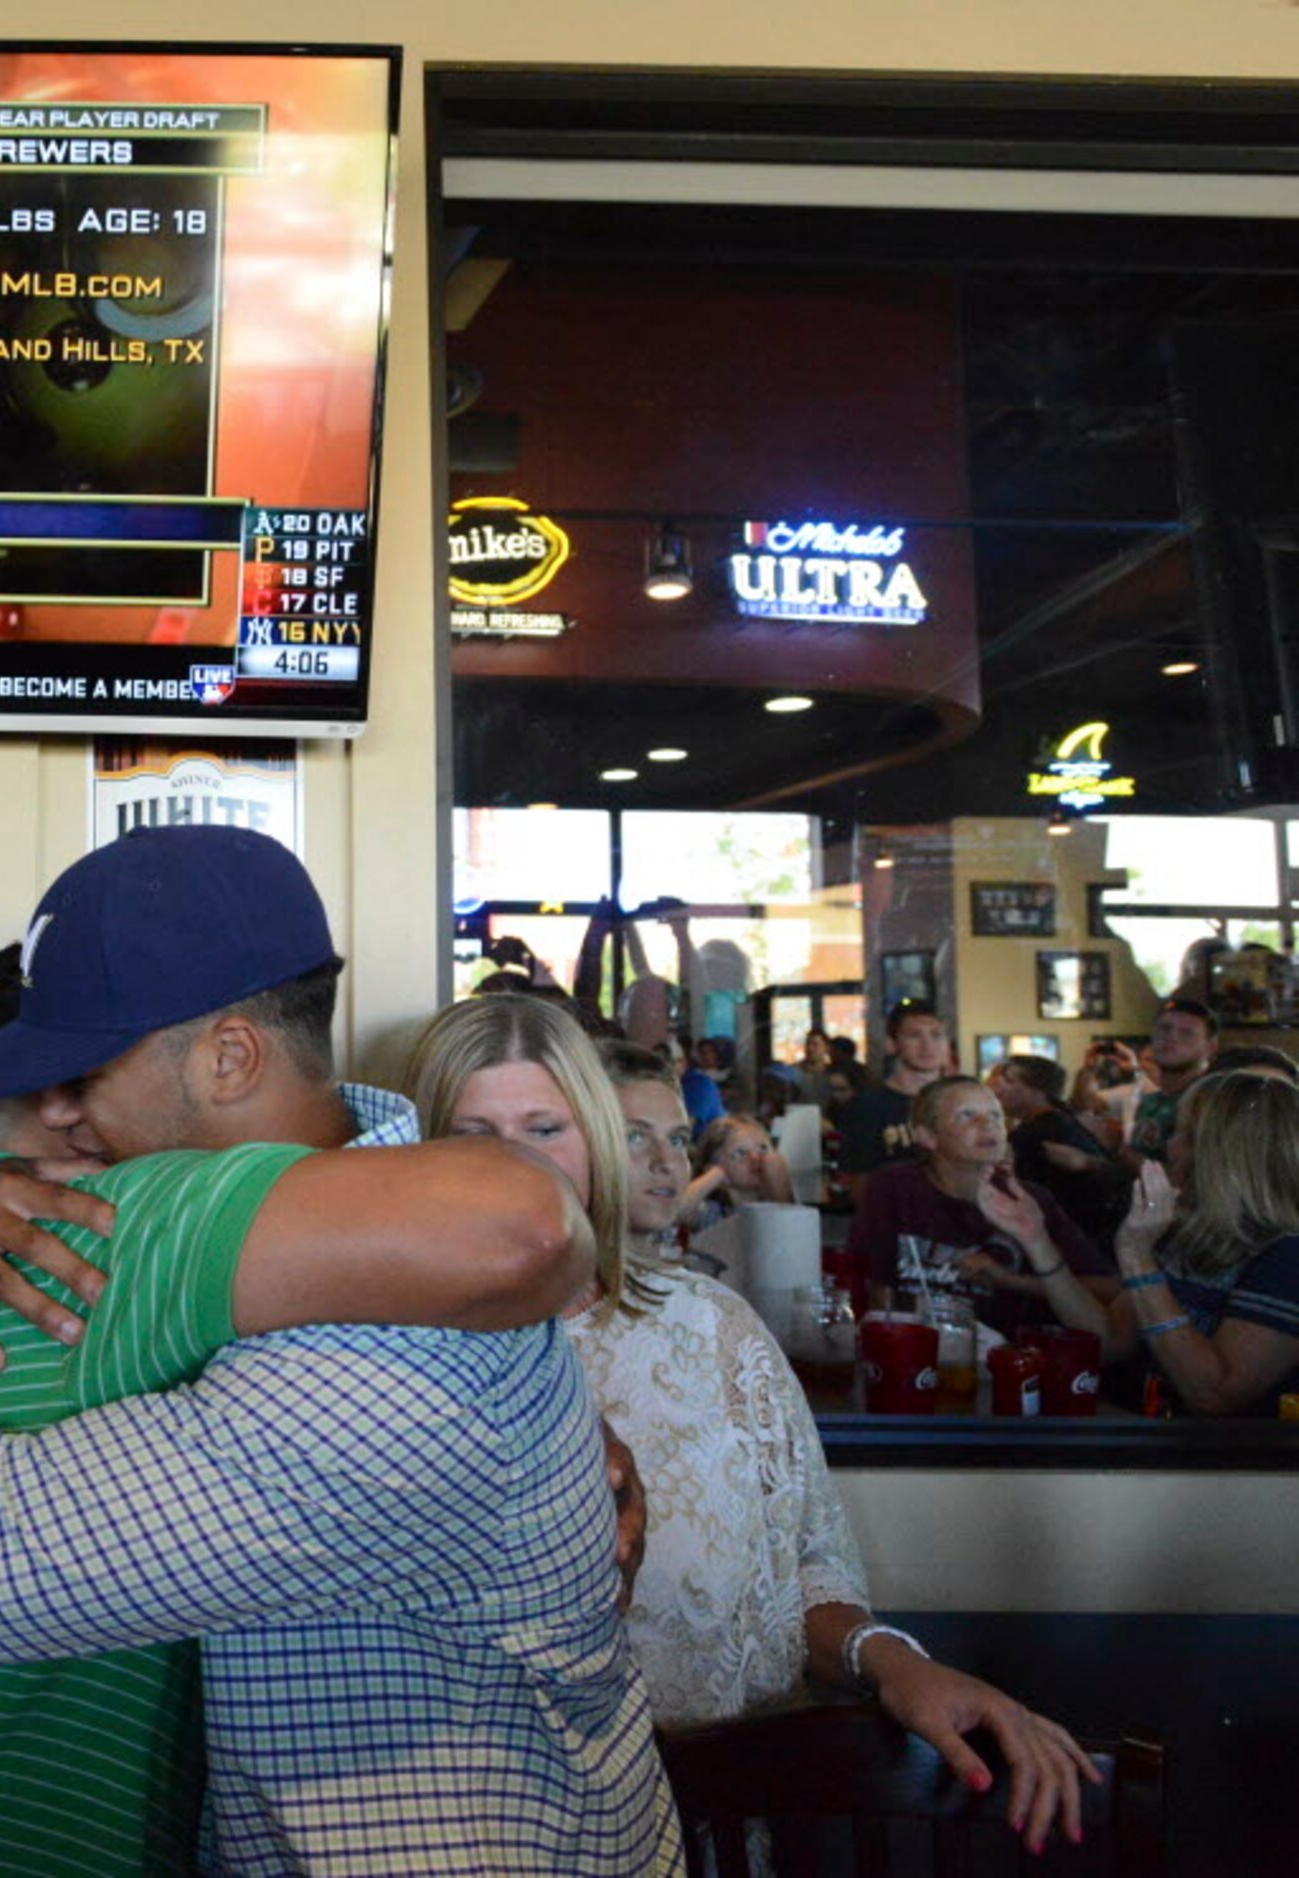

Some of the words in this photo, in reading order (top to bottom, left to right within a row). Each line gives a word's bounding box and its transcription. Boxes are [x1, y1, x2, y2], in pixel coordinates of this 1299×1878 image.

[49, 111, 140, 129] PLAYER
[144, 112, 220, 130] DRAFT
[77, 209, 161, 233] AGE:
[172, 211, 208, 234] 18
[1, 275, 162, 298] MLB.COM
[62, 338, 154, 364] HILLS,
[164, 340, 205, 363] TX
[283, 514, 311, 533] 20
[317, 512, 366, 536] OAK
[283, 540, 309, 560] 19
[316, 541, 354, 562] PIT
[281, 567, 308, 587] 18
[313, 566, 345, 588] SF
[730, 553, 928, 610] ULTRA
[280, 594, 307, 613] 17
[312, 594, 358, 615] CLE
[278, 622, 305, 642] 16
[274, 650, 329, 675] 4:06
[193, 667, 233, 684] LIVE
[0, 676, 87, 698] BECOME
[92, 677, 109, 698] A
[115, 679, 196, 699] MEMBE
